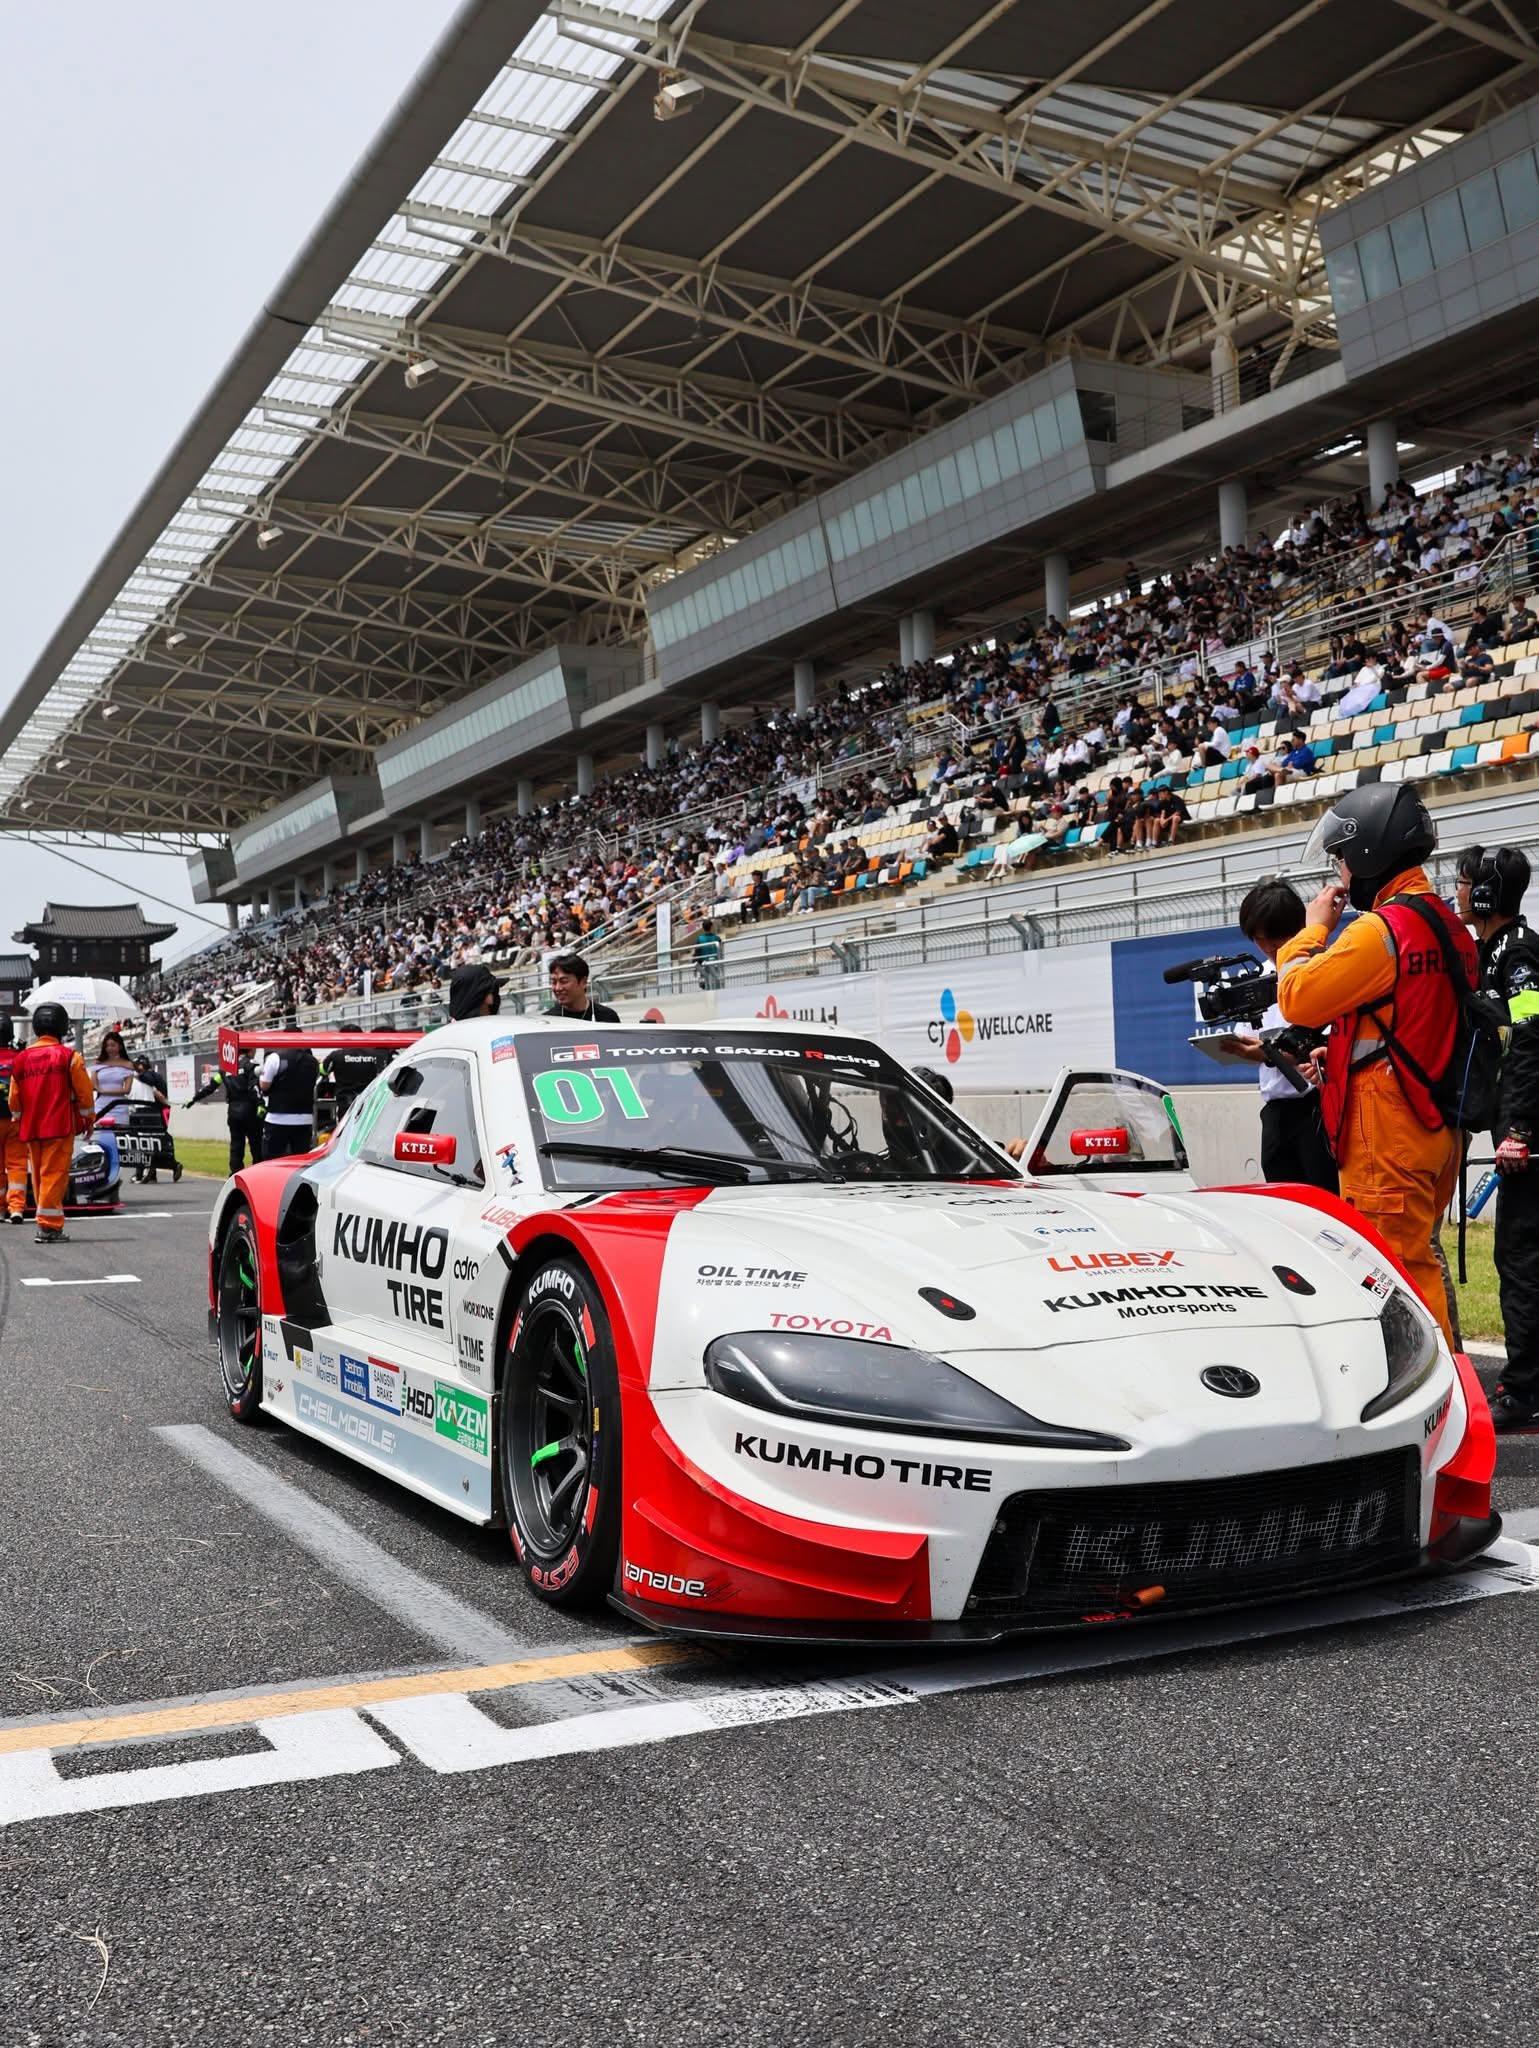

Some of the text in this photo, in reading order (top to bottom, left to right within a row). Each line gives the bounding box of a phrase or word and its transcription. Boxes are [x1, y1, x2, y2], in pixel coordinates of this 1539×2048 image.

[927, 1013, 1053, 1048] CJ WELLCARE
[552, 1046, 880, 1068] GR TOYOTA GAZOO Racing
[533, 1067, 649, 1124] 01
[401, 1142, 437, 1155] KTEL
[1085, 1137, 1120, 1147] KTEL
[119, 1152, 152, 1167] obility
[1054, 1226, 1097, 1235] PILOT
[333, 1212, 449, 1280] KUMHO
[698, 1265, 808, 1282] OIL TIME
[1047, 1250, 1184, 1272] LUBEX
[1085, 1267, 1174, 1277] SMART CHOICE
[529, 1268, 575, 1304] KUMHO
[1043, 1285, 1269, 1313] KUMHO TIRE
[387, 1279, 444, 1330] TIRE
[1118, 1301, 1237, 1319] Motorsports
[770, 1313, 893, 1342] TOYOTA
[463, 1335, 484, 1362] TIME
[376, 1385, 393, 1403] BRAKE
[406, 1386, 435, 1419] HSD
[436, 1394, 487, 1439] KAZEN
[735, 1432, 992, 1492] KUMHO TIRE
[1064, 1488, 1389, 1576] KUMHO
